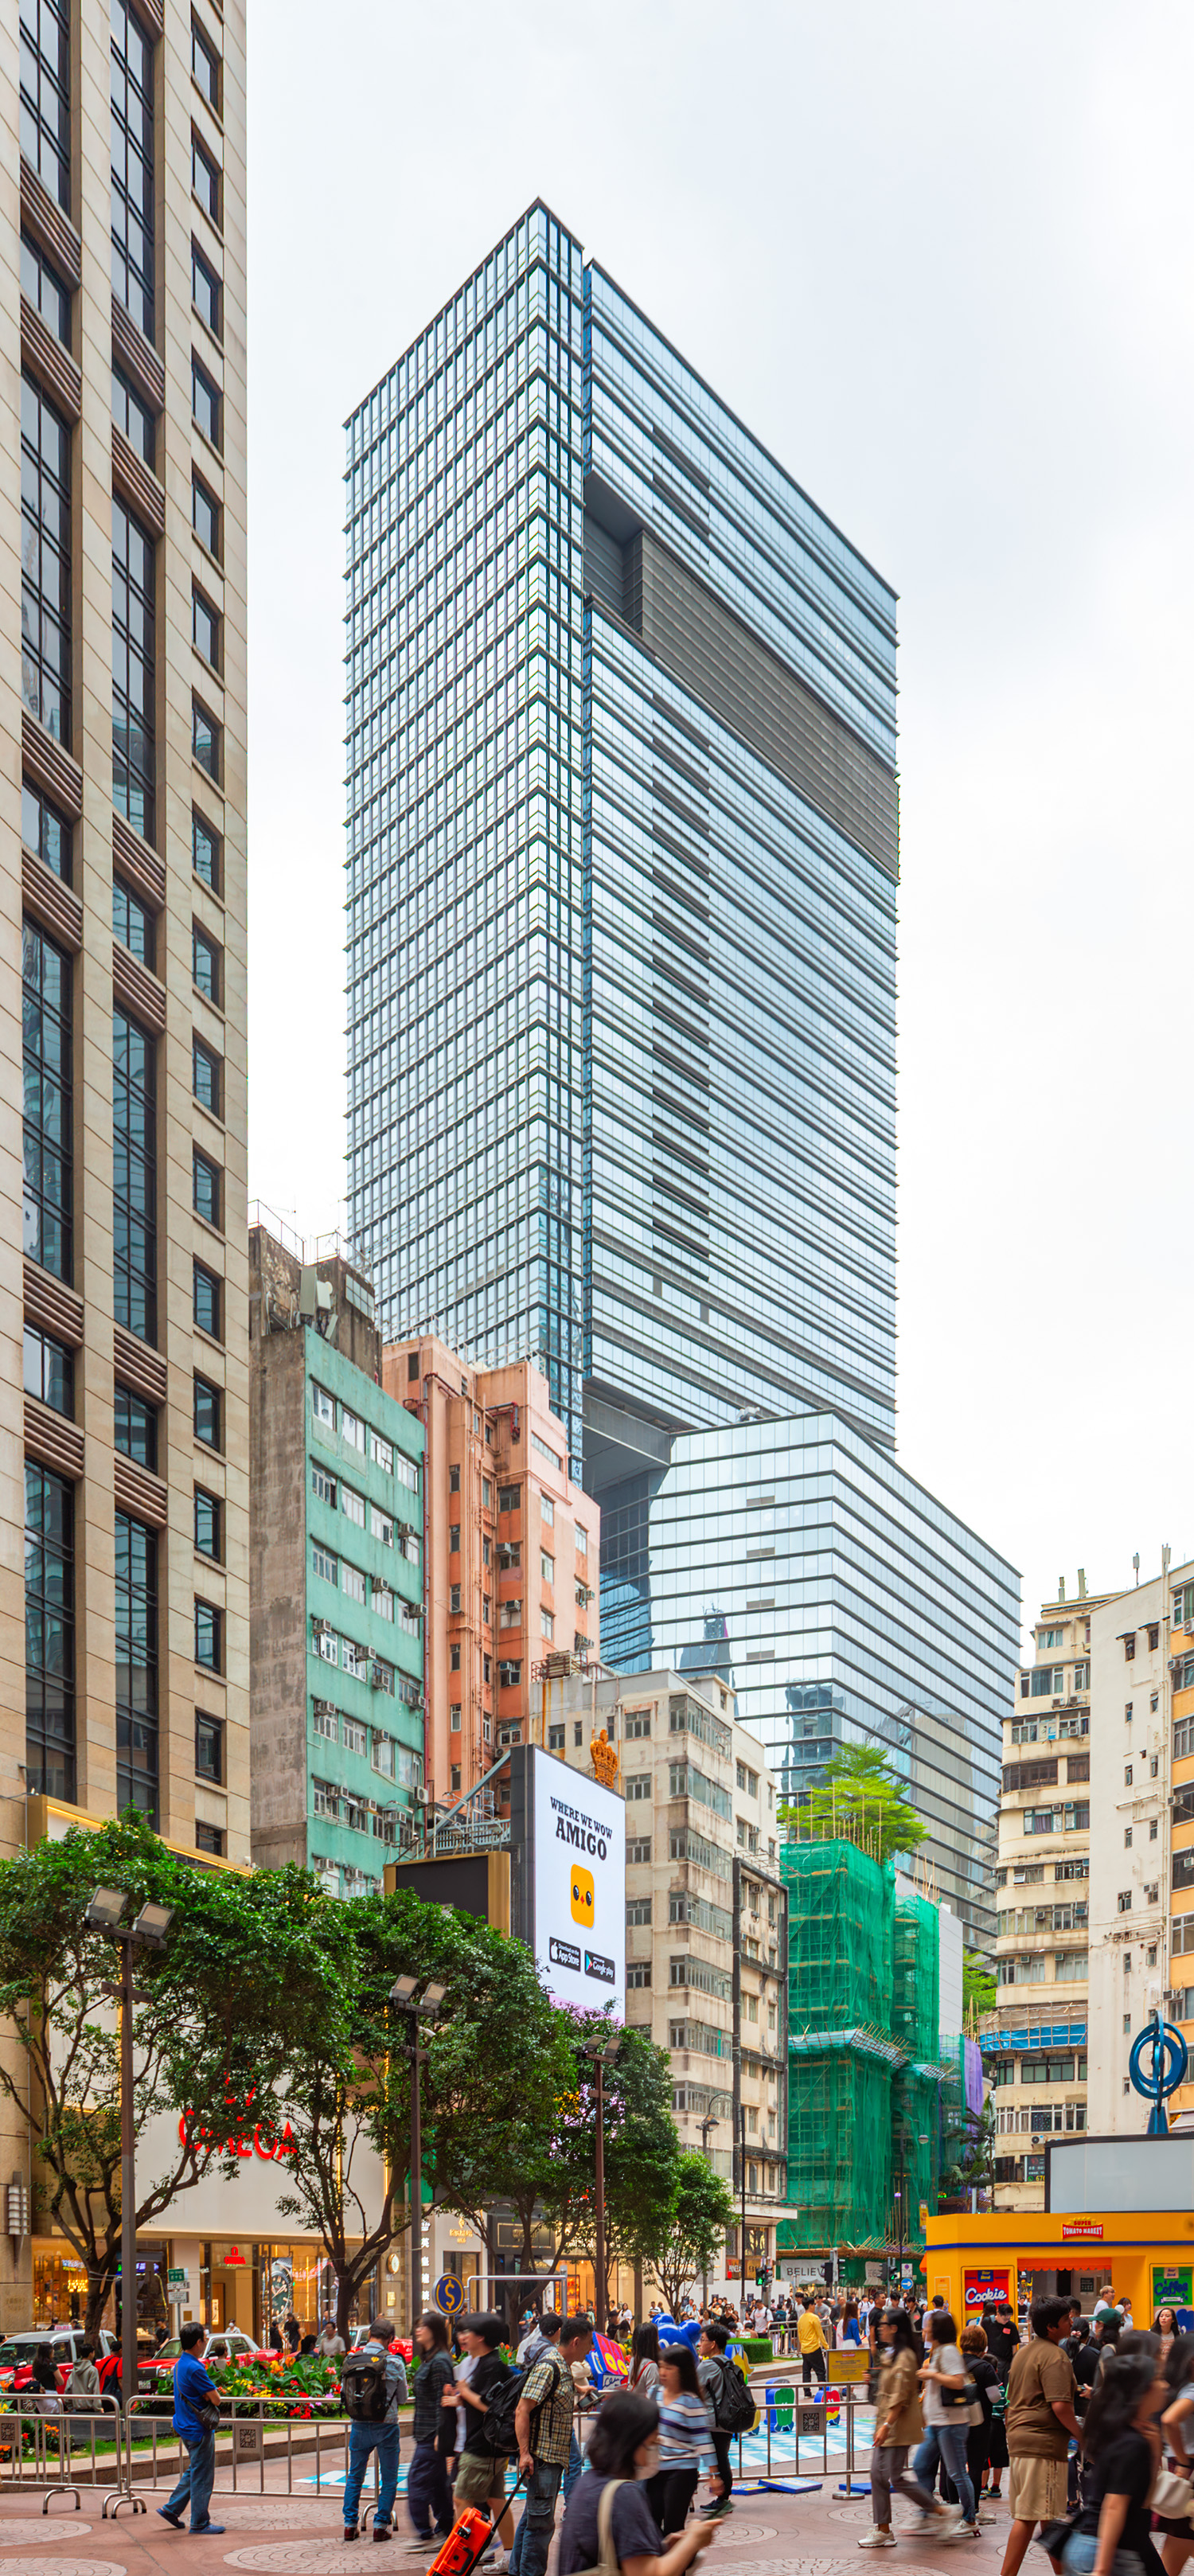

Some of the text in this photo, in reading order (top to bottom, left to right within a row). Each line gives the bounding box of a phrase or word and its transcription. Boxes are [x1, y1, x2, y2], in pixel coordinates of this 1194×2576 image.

[550, 1796, 613, 1840] WHERE WE WOW
[556, 1816, 607, 1861] AMIGO
[558, 1950, 568, 1964] App
[568, 1953, 579, 1966] Store
[592, 1961, 607, 1976] Google
[1063, 2227, 1102, 2235] TOMATO MARKET
[786, 2267, 825, 2277] BELIEV
[965, 2287, 1008, 2304] Cookie
